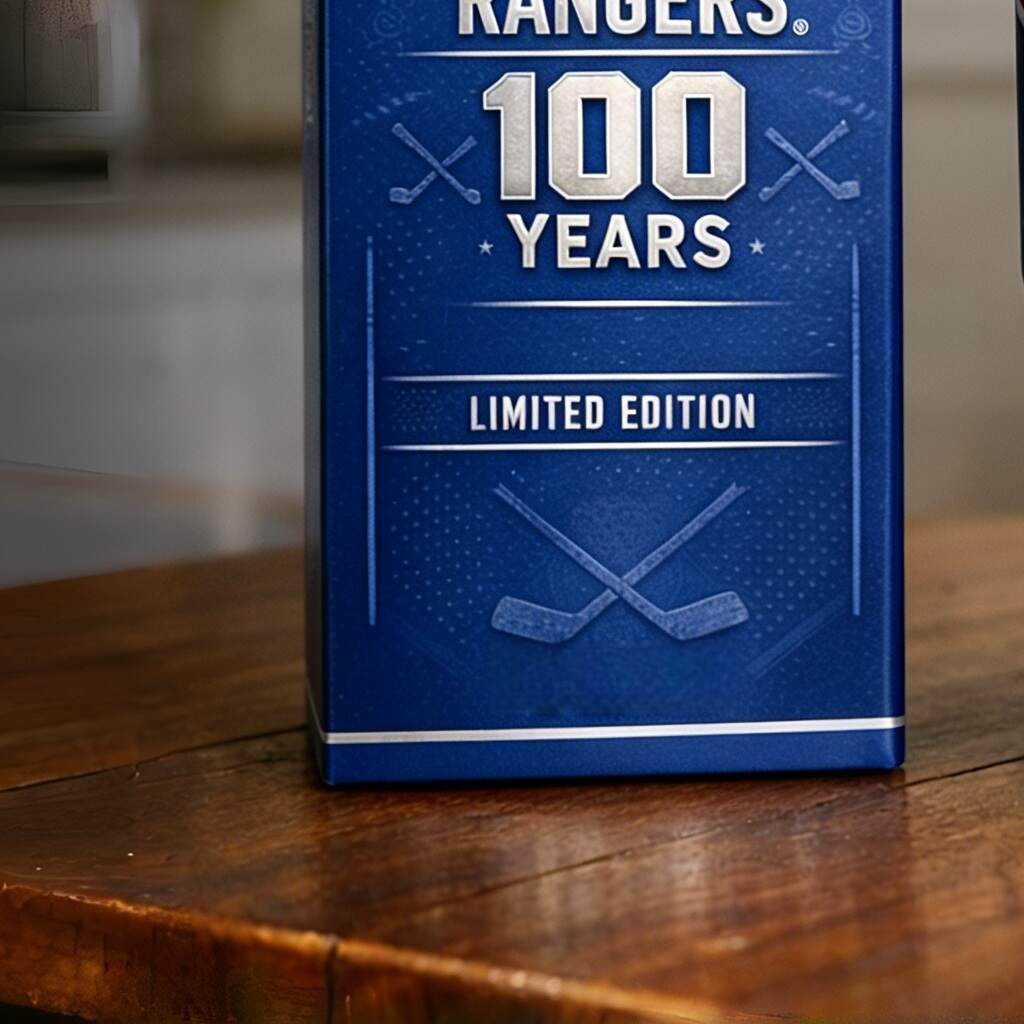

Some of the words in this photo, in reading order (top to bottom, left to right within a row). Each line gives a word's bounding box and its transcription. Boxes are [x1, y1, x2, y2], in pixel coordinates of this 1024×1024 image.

[482, 70, 747, 201] 100
[506, 213, 731, 269] YEARS
[470, 394, 604, 432] LIMITED
[620, 393, 756, 431] EDITION
